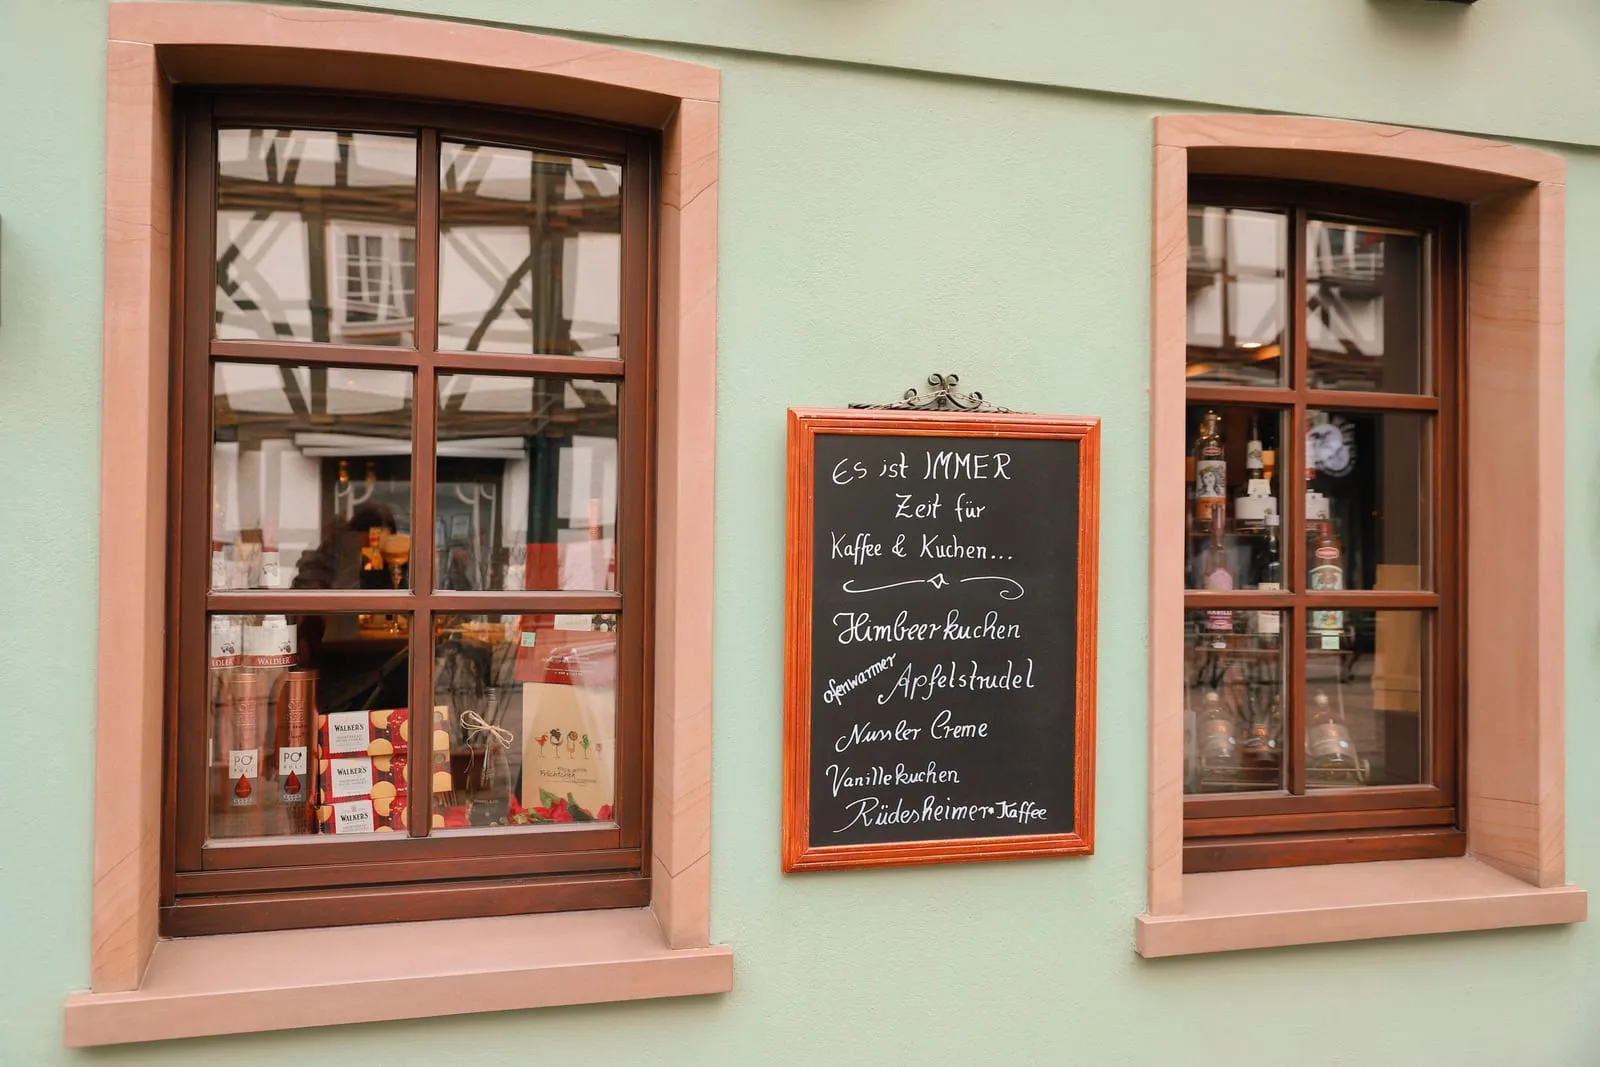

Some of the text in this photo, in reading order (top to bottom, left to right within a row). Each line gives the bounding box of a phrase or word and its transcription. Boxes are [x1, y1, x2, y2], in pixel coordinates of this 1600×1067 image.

[831, 450, 1012, 485] Es ist IMMER
[894, 492, 986, 522] Zeit für
[831, 531, 882, 566] Kaffee
[891, 533, 908, 558] &
[832, 609, 1021, 644] Himbeerkuchen
[823, 652, 1035, 706] ofenwarmer Apfelstrudel
[930, 709, 989, 740] Creme
[825, 761, 961, 798] Vanillekuchen
